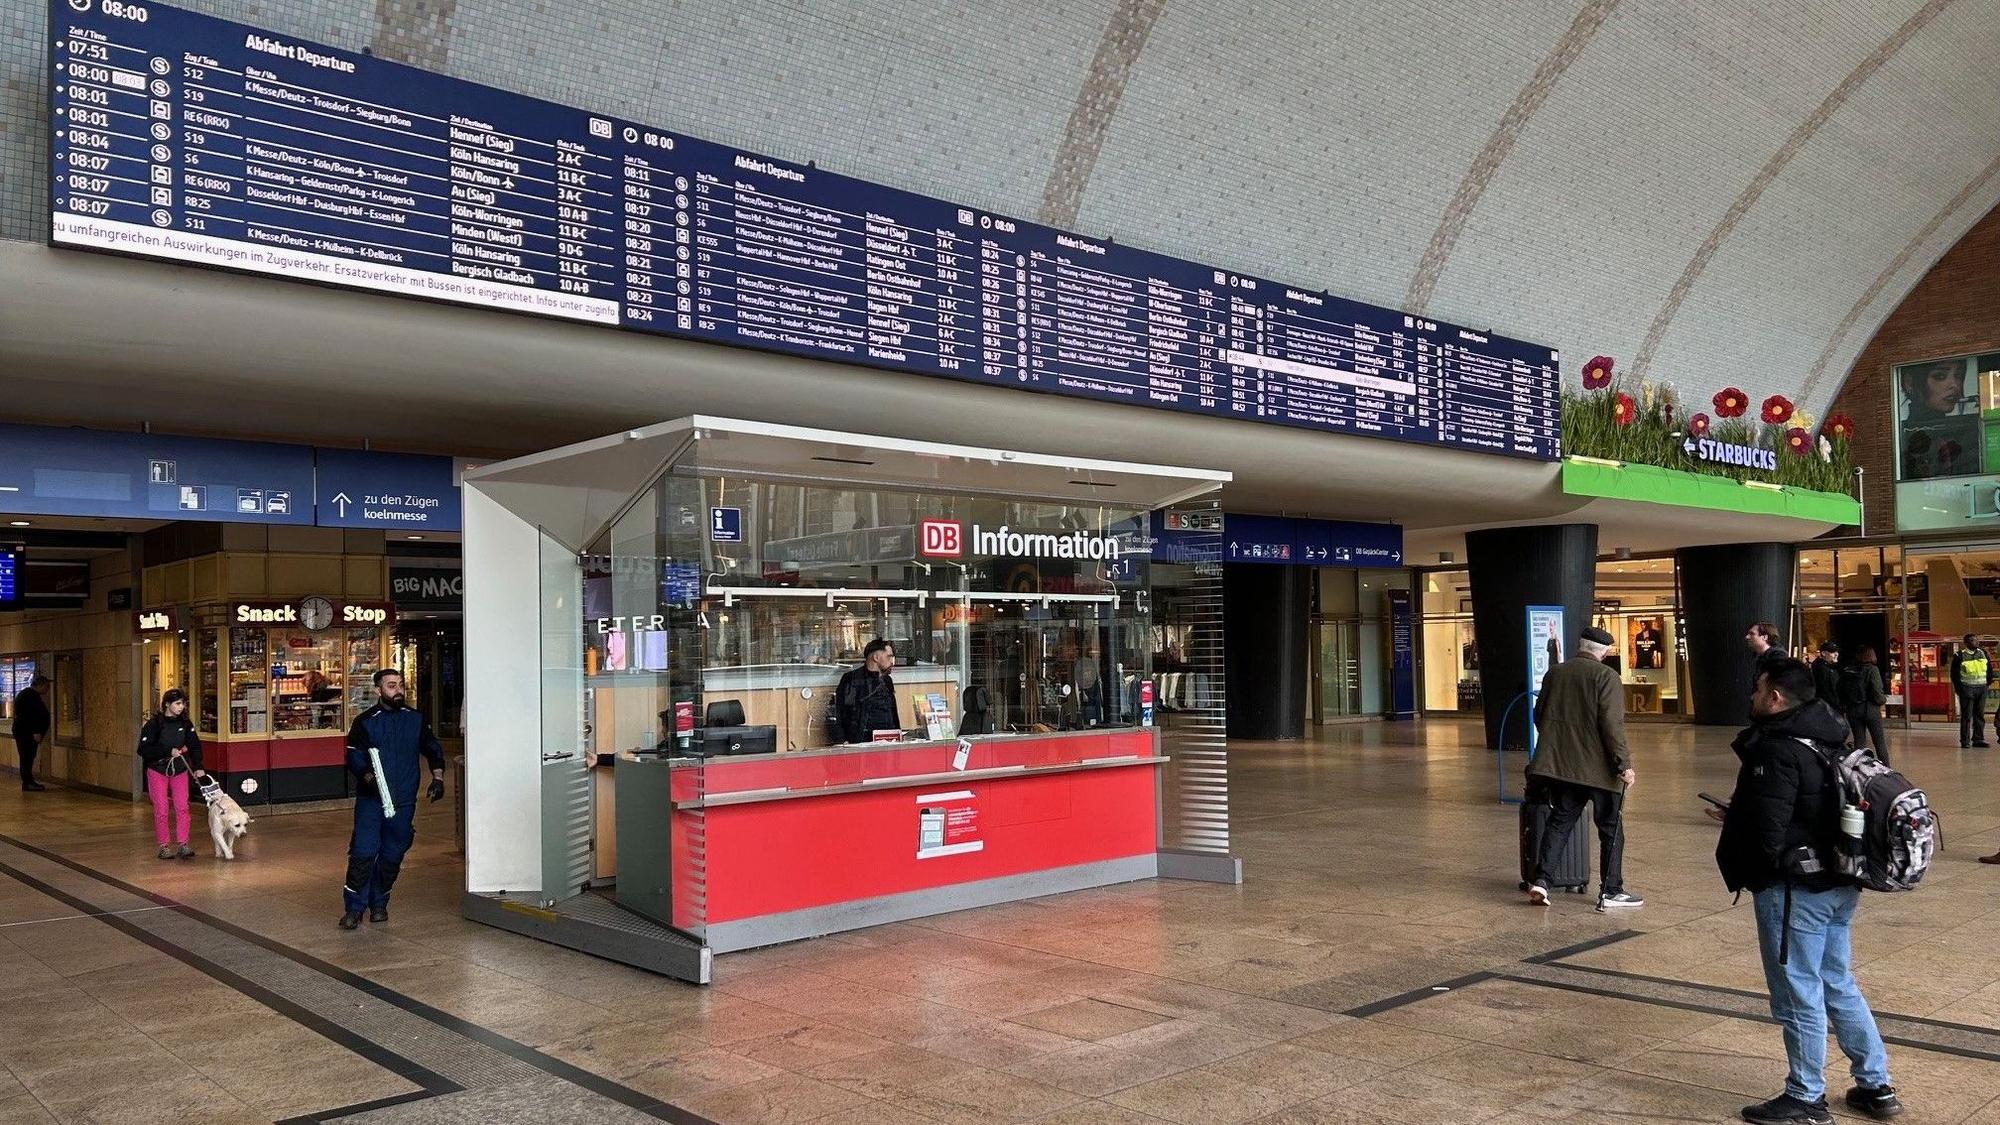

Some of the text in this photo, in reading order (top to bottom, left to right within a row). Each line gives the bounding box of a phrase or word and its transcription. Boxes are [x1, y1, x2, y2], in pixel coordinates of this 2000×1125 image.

[101, 0, 148, 23] 08:00
[69, 40, 108, 60] 07:51
[245, 34, 356, 74] Abfahrt Departure
[69, 63, 108, 83] 08:00
[69, 85, 108, 105] 08:01
[69, 107, 109, 127] 08:01
[312, 96, 350, 112] Troisdorf
[356, 106, 411, 127] Siegburg/Bonn
[590, 118, 611, 138] DB
[69, 130, 109, 149] 08:04
[450, 126, 514, 153] Hennef (Sieg)
[69, 152, 109, 170] 08:07
[450, 146, 519, 174] Köln Hansaring
[735, 155, 806, 183] Abfahrt Departure
[373, 170, 407, 185] Troisdorf
[451, 165, 500, 186] Köln/Bonn
[624, 166, 650, 181] 08:11
[69, 175, 109, 192] 08:07
[254, 166, 294, 185] Hansaring
[371, 190, 415, 206] K-Longerich
[624, 184, 650, 199] 08:14
[451, 185, 495, 205] Au (Sieg)
[69, 197, 110, 215] 08:07
[451, 203, 523, 228] Köln-Worringen
[625, 202, 650, 216] 08:17
[451, 222, 522, 247] Minden (Westf)
[625, 219, 651, 234] 08:20
[866, 222, 908, 241] Hennef (Sieg)
[625, 237, 651, 251] 08:20
[866, 237, 900, 253] Düsseldorf
[452, 242, 520, 266] Köln Hansaring
[626, 254, 652, 269] 08:21
[866, 253, 906, 270] Ratingen Ost
[69, 224, 159, 245] umfangreichen
[163, 236, 247, 261] Auswirkungen
[251, 253, 263, 262] im
[267, 252, 333, 272] Zugverkehr.
[334, 263, 406, 284] Ersatzverkehr
[410, 278, 424, 287] mit
[428, 277, 461, 292] Bussen
[464, 287, 475, 295] ist
[537, 295, 557, 307] Infos
[560, 302, 582, 310] unter
[586, 305, 615, 316] zuginfo
[452, 261, 534, 284] Bergisch Gladbach
[626, 272, 652, 286] 08:21
[867, 269, 921, 288] Berlin Ostbahnhof
[627, 290, 652, 303] 08:23
[867, 284, 912, 304] Köln Hansaring
[627, 307, 652, 321] 08:24
[867, 300, 899, 314] Hagen Hbf
[868, 315, 910, 333] Hennef (Sieg)
[868, 331, 901, 345] Siegen Hbf
[868, 347, 906, 361] Marienheide
[1699, 438, 1776, 471] STARBUCKS
[364, 494, 439, 509] zu den Zügen
[364, 507, 428, 521] koelnmesse
[924, 522, 1119, 560] DB Information
[421, 576, 464, 599] MAC
[236, 604, 387, 625] Snack Stop
